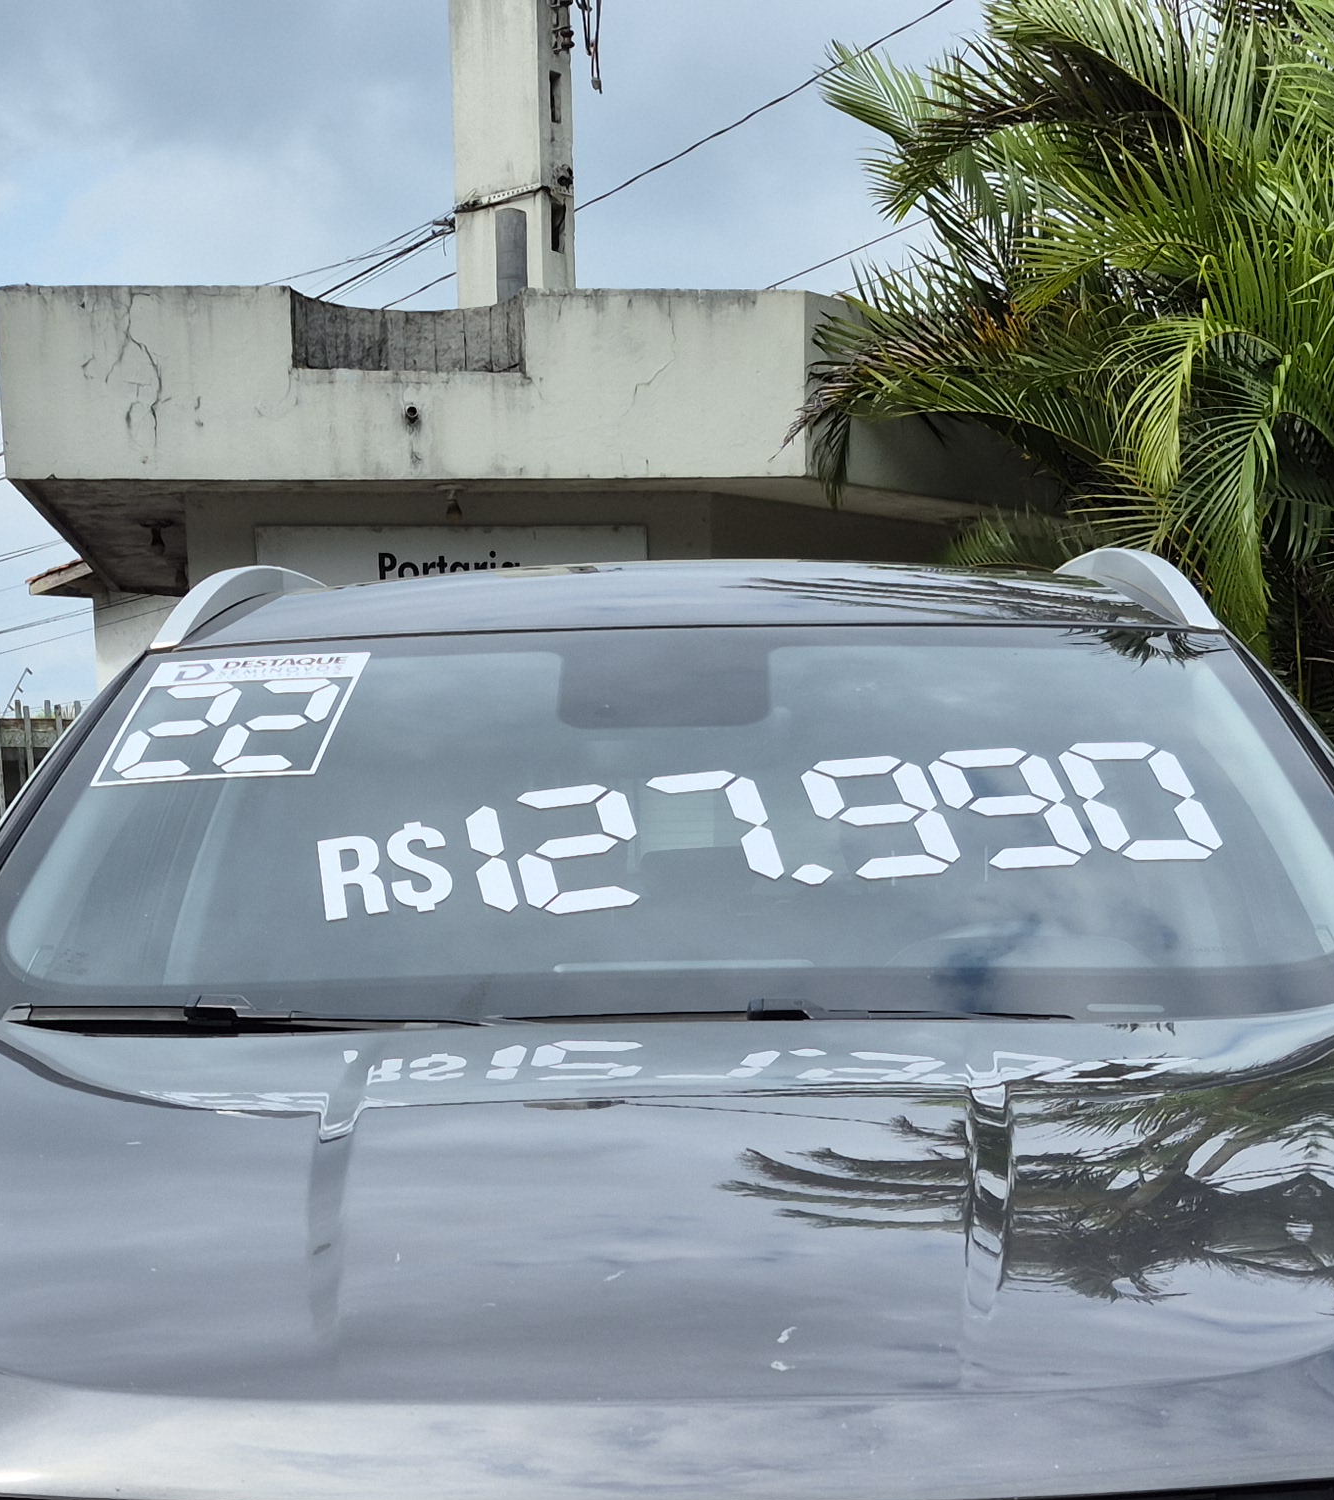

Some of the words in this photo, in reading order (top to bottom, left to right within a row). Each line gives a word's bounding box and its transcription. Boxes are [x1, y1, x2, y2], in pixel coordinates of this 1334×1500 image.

[378, 550, 521, 580] Porti
[219, 664, 343, 677] SEMINOVOS
[222, 656, 349, 670] DESTAQUE
[112, 677, 341, 779] 22
